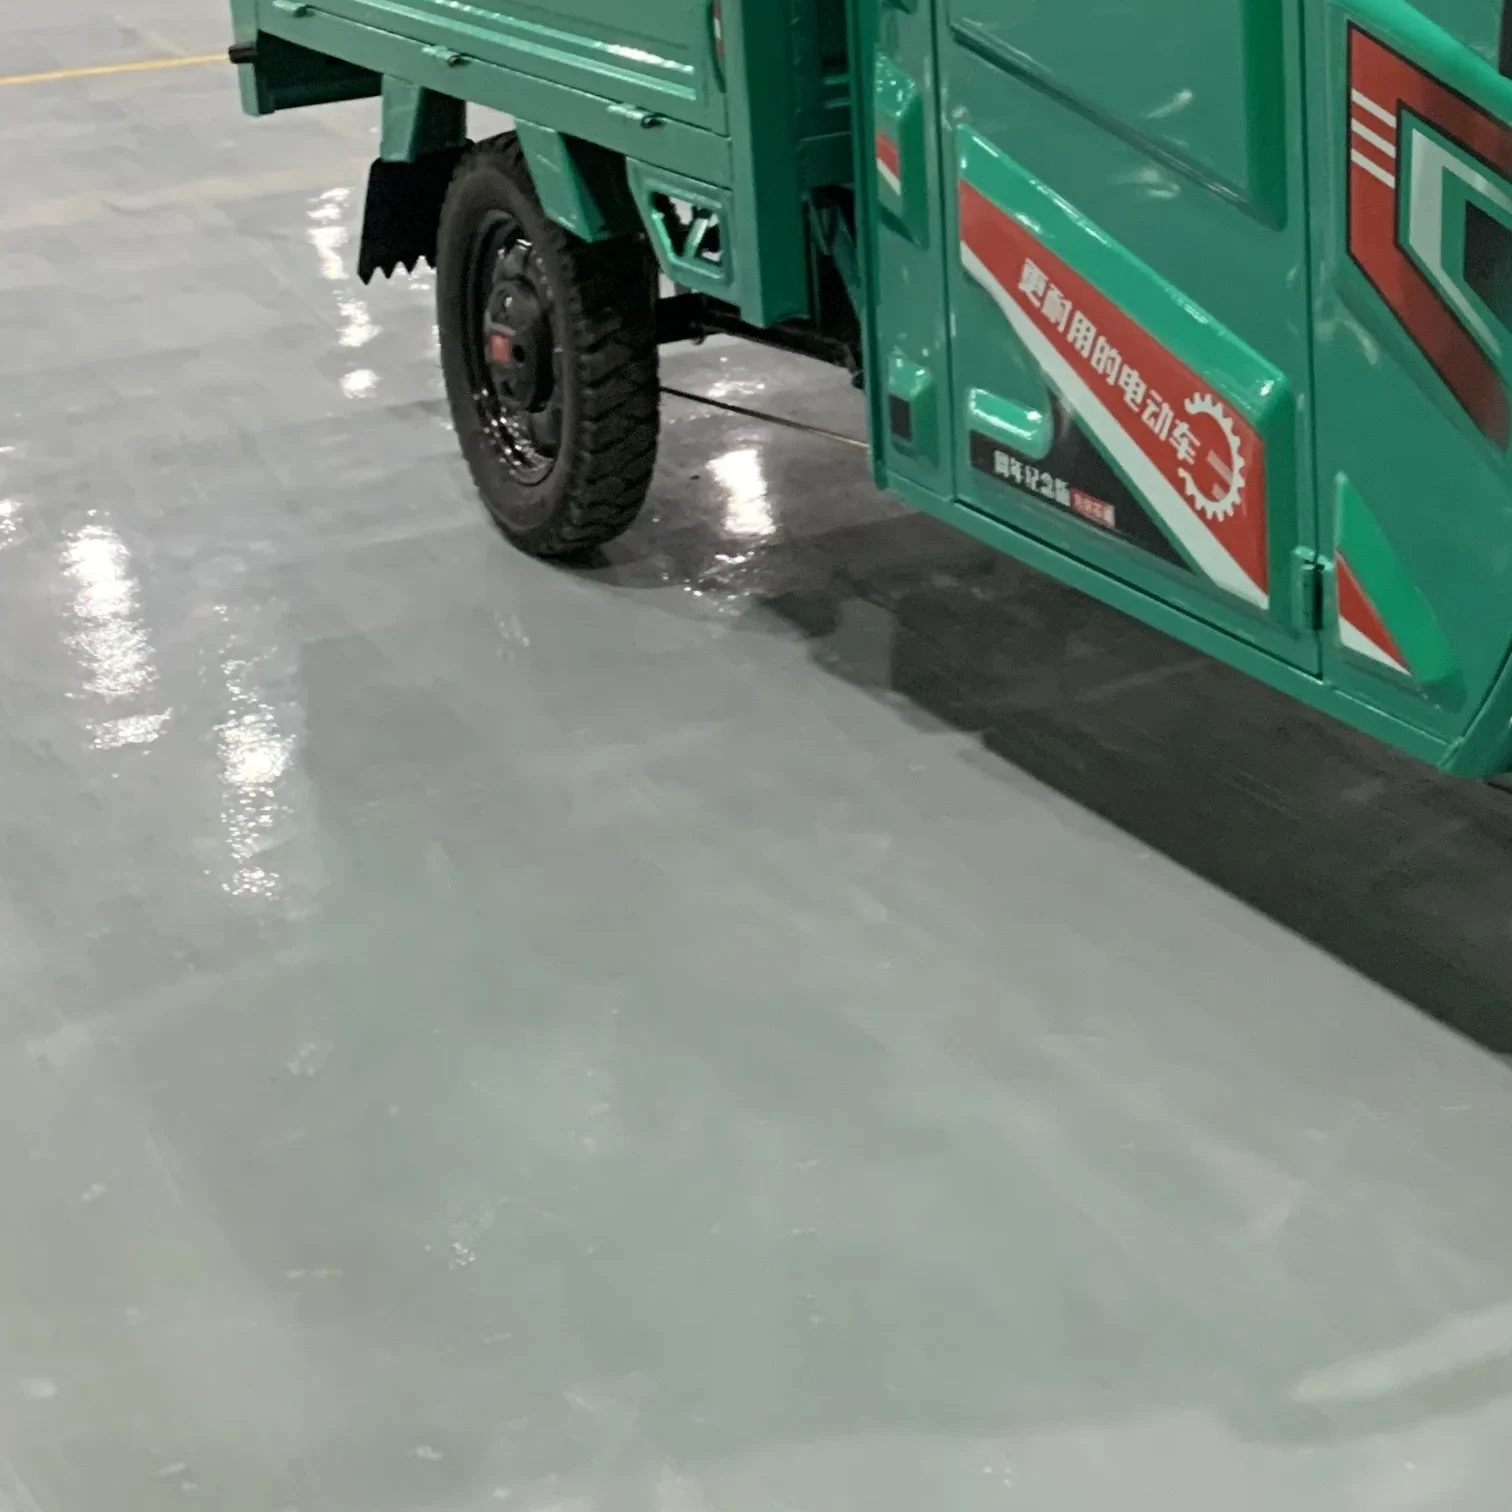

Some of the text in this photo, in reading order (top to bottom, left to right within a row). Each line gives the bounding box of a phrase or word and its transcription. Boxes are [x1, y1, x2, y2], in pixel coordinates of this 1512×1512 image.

[1018, 257, 1201, 465] 更耐用的电动车
